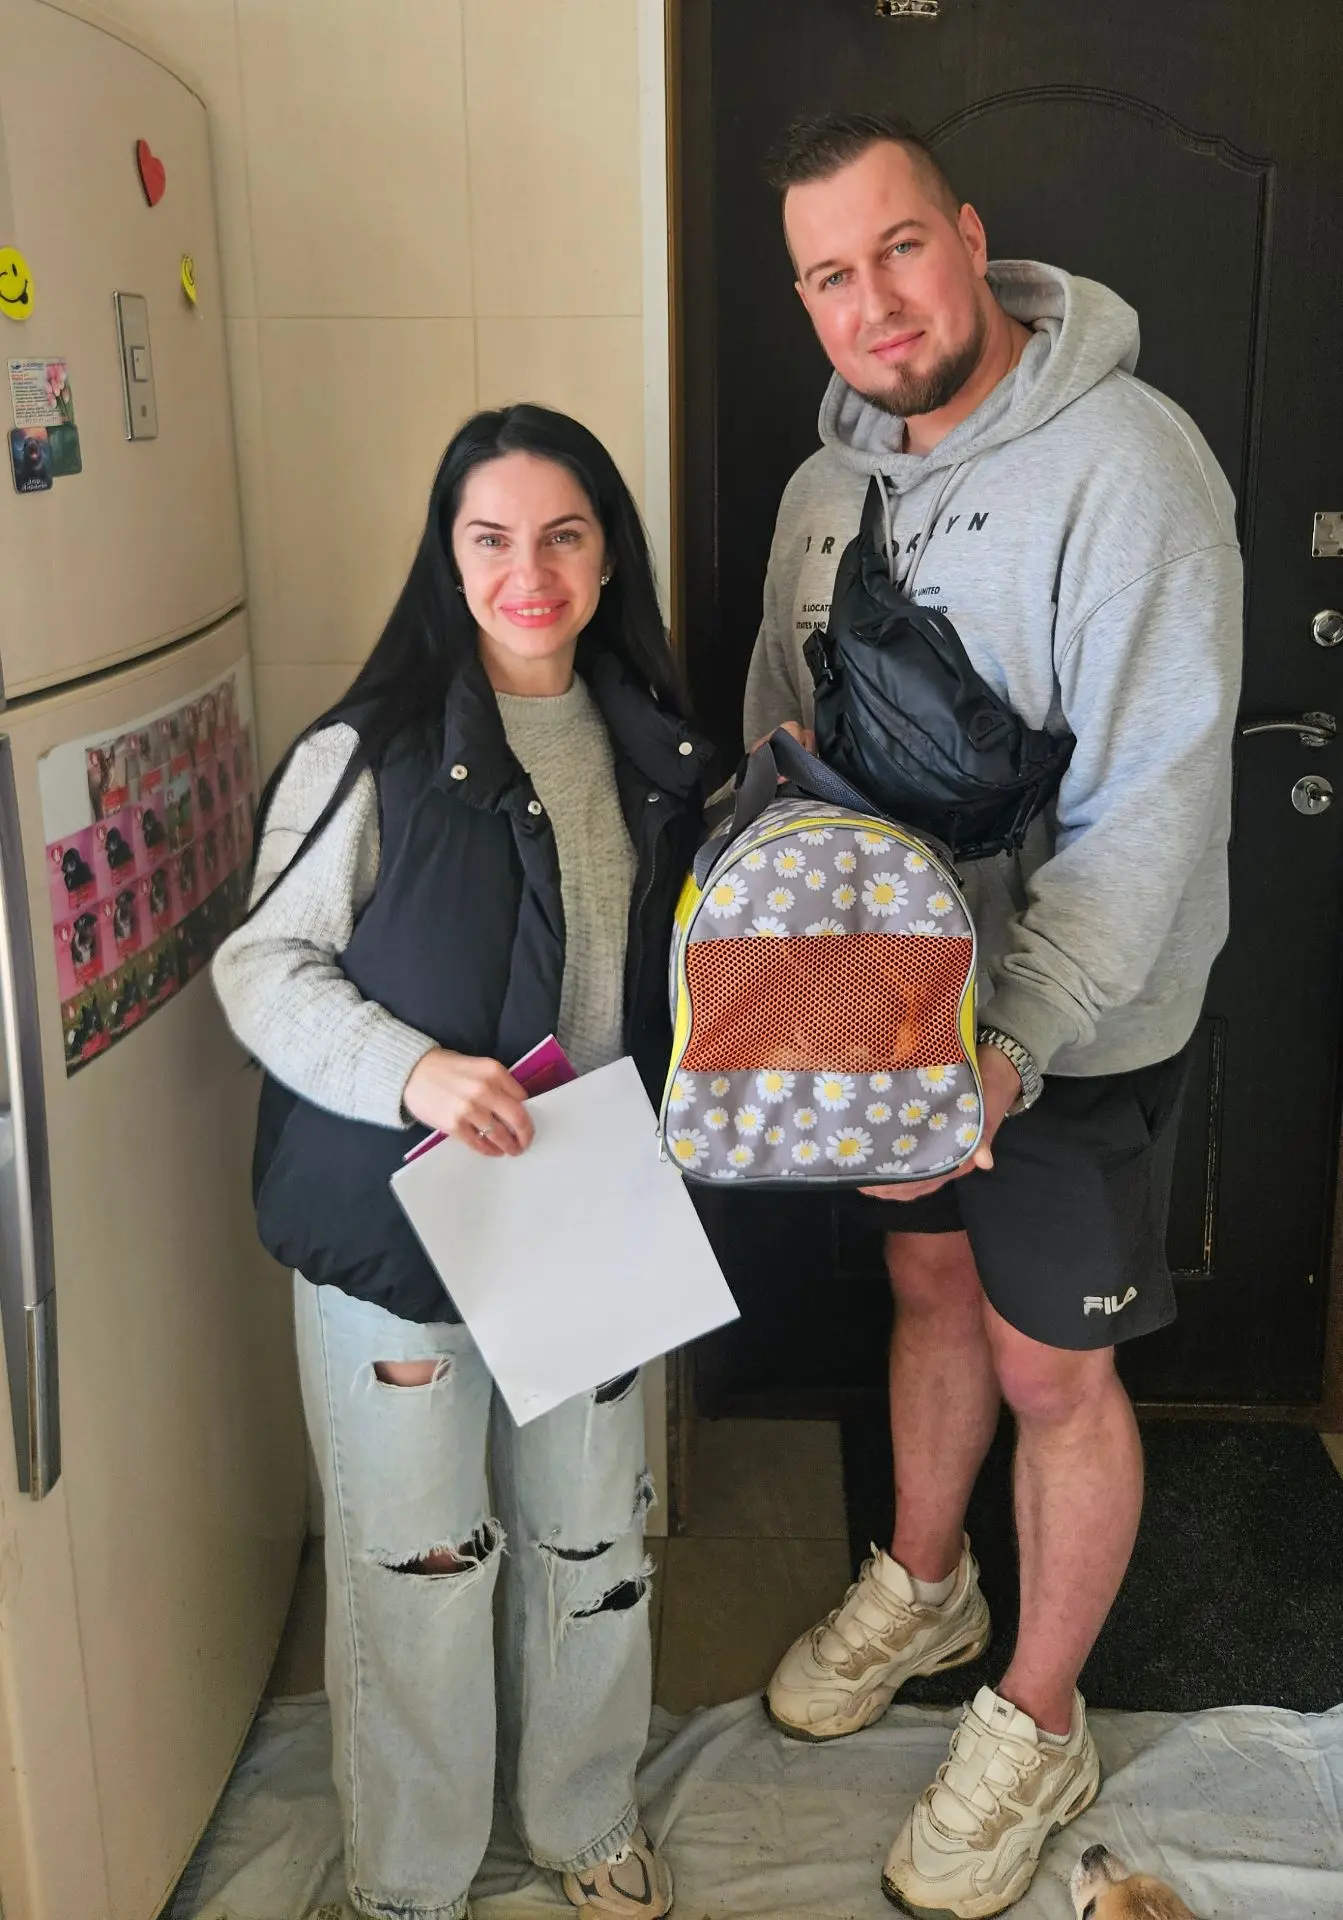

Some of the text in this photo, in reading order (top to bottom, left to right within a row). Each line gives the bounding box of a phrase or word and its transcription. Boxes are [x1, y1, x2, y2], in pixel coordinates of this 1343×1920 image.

[807, 603, 832, 612] LOCAT
[918, 586, 941, 597] UNITED
[1083, 1286, 1138, 1317] FILA
